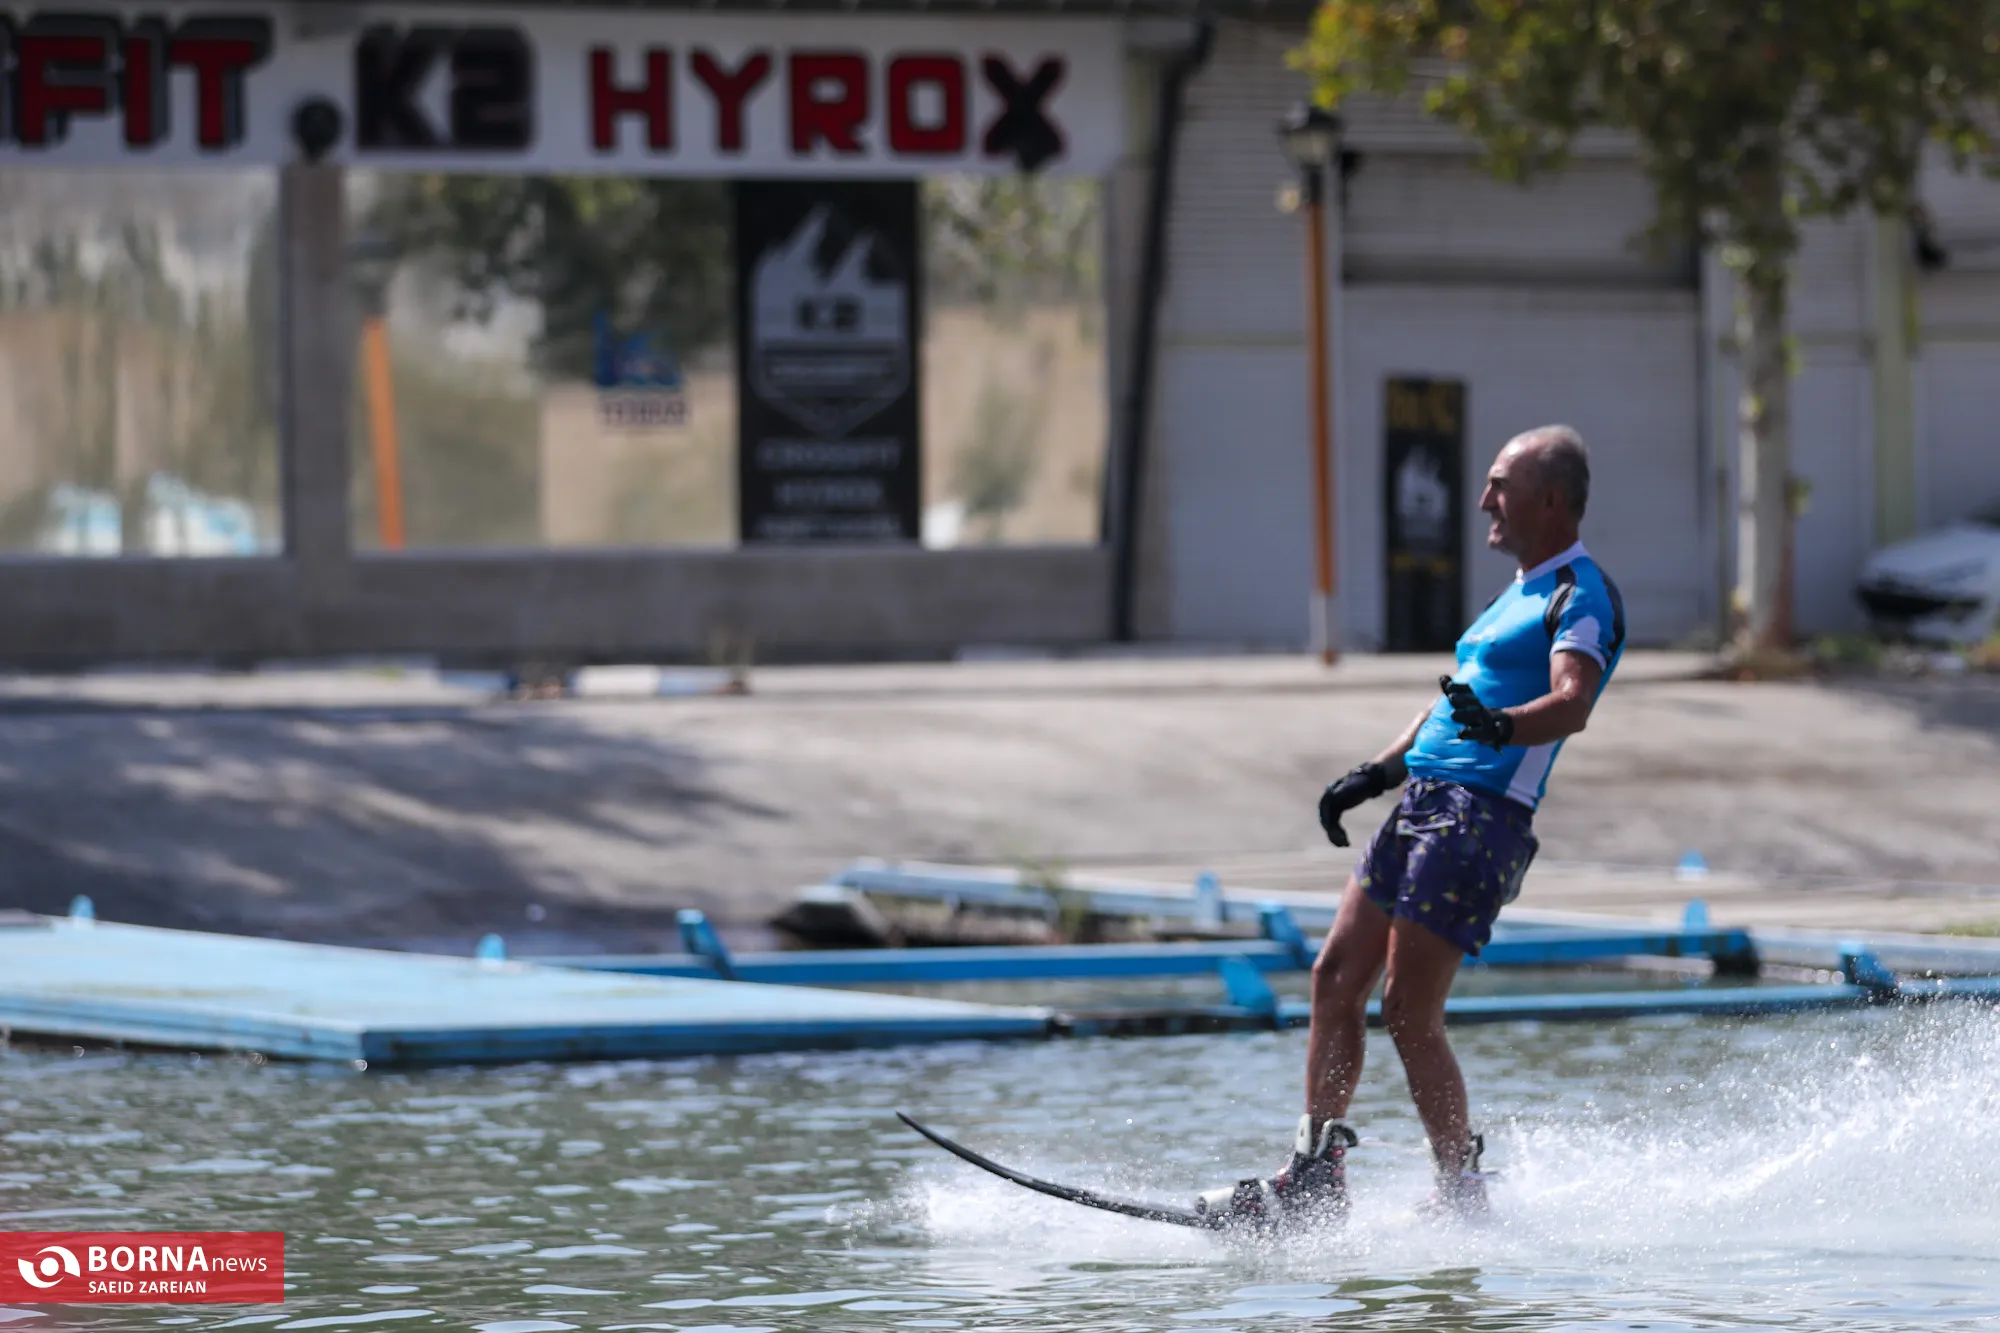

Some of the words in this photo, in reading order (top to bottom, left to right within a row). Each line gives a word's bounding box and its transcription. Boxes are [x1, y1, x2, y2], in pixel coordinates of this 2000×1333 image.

[0, 15, 272, 151] FIT
[354, 22, 536, 152] K2
[587, 45, 1068, 160] HYROX
